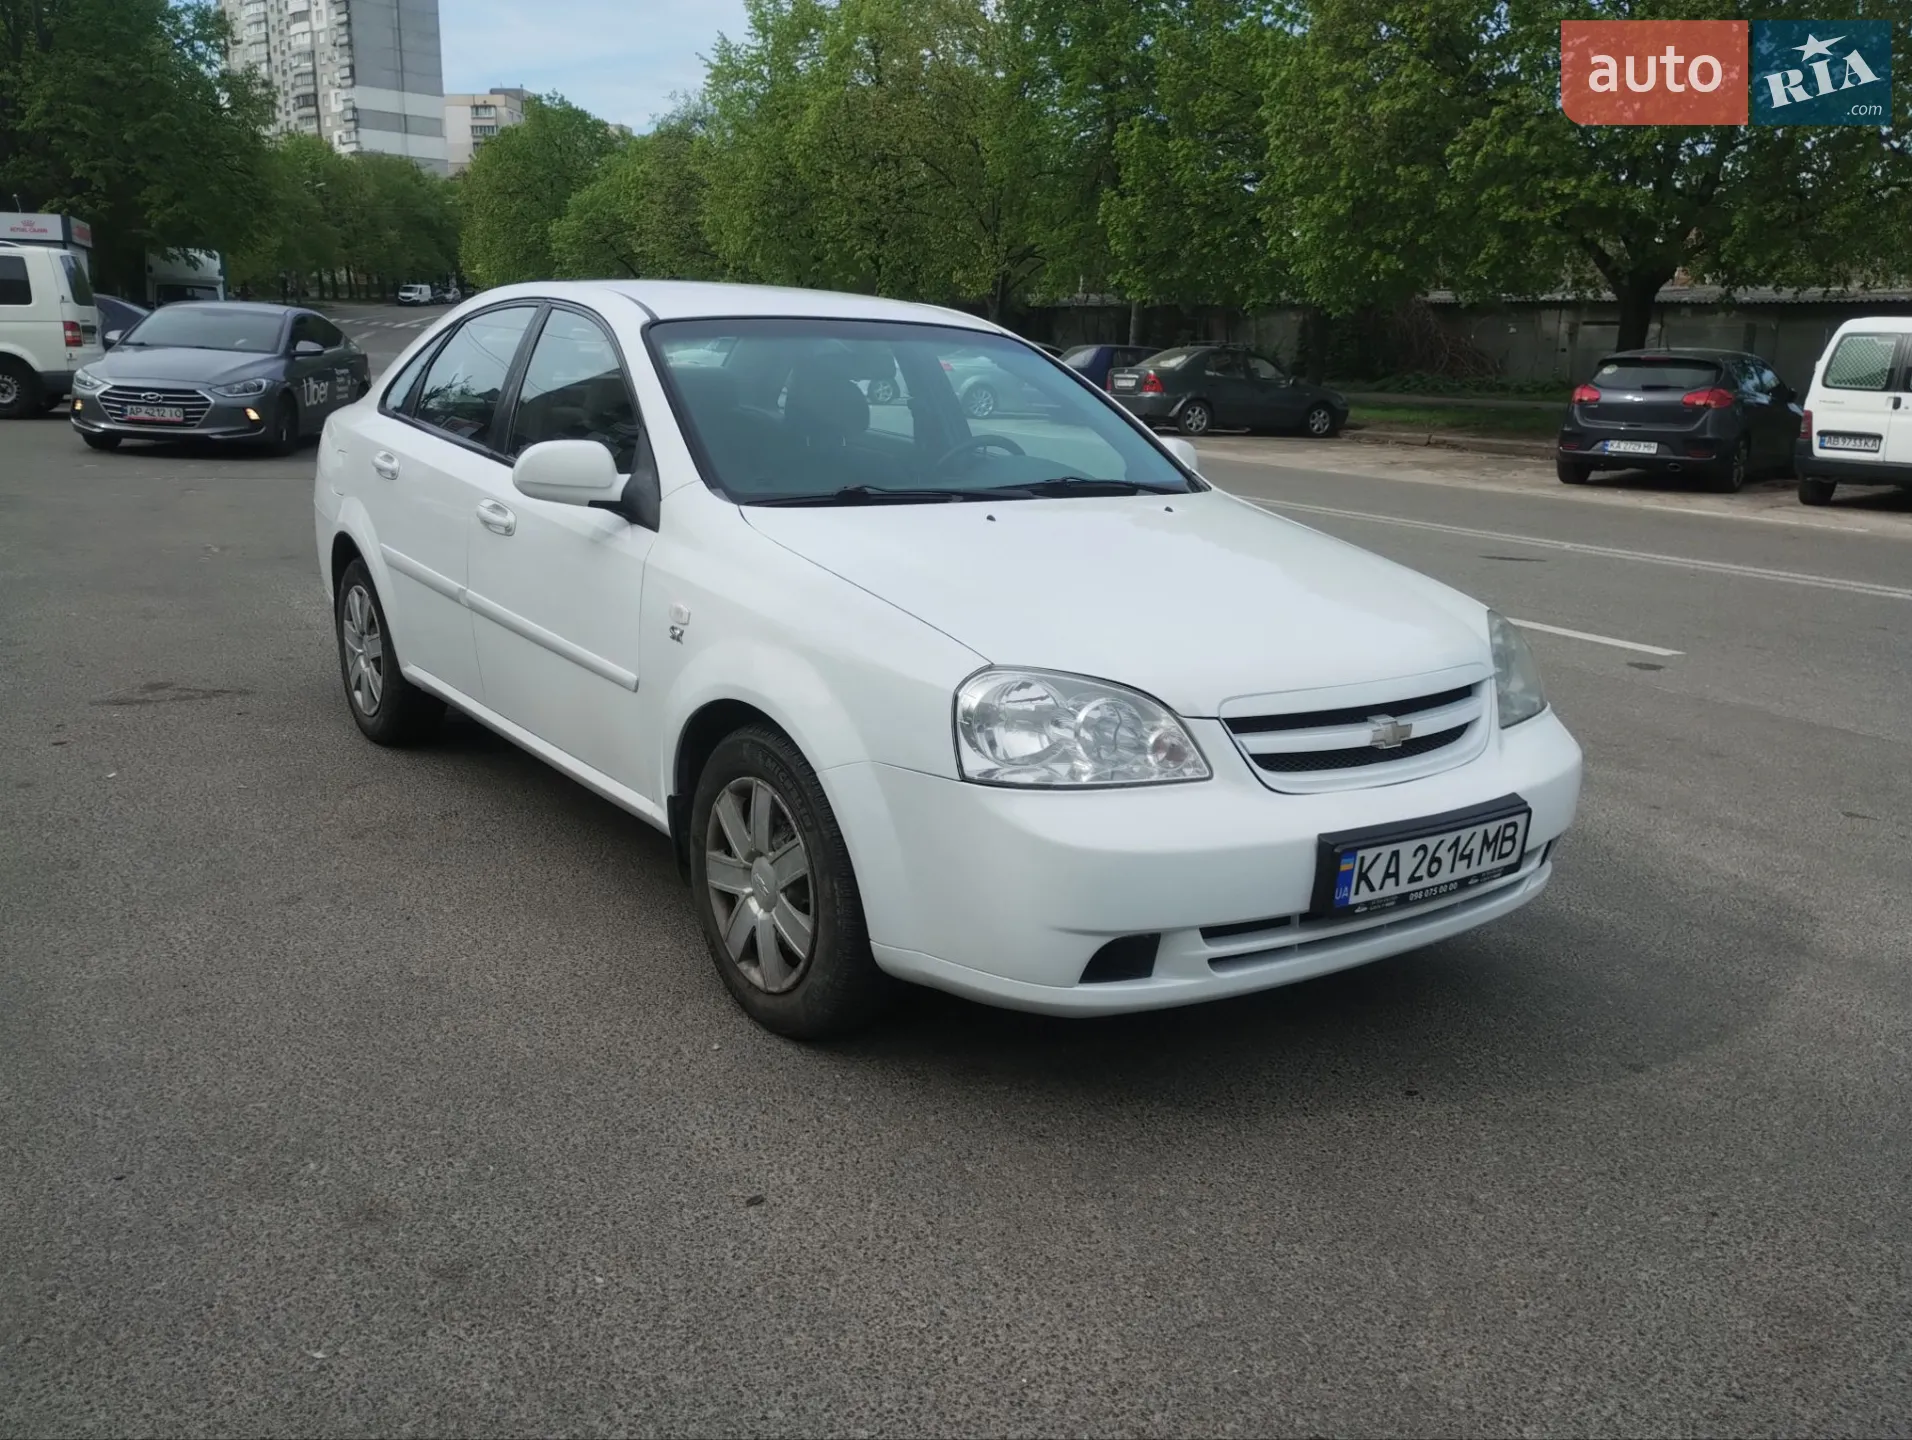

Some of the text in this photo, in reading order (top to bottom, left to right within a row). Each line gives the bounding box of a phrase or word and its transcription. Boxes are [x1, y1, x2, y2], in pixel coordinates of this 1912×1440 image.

[303, 376, 329, 407] Uber
[1353, 820, 1519, 895] KA 2614 MB
[1334, 886, 1350, 901] UA
